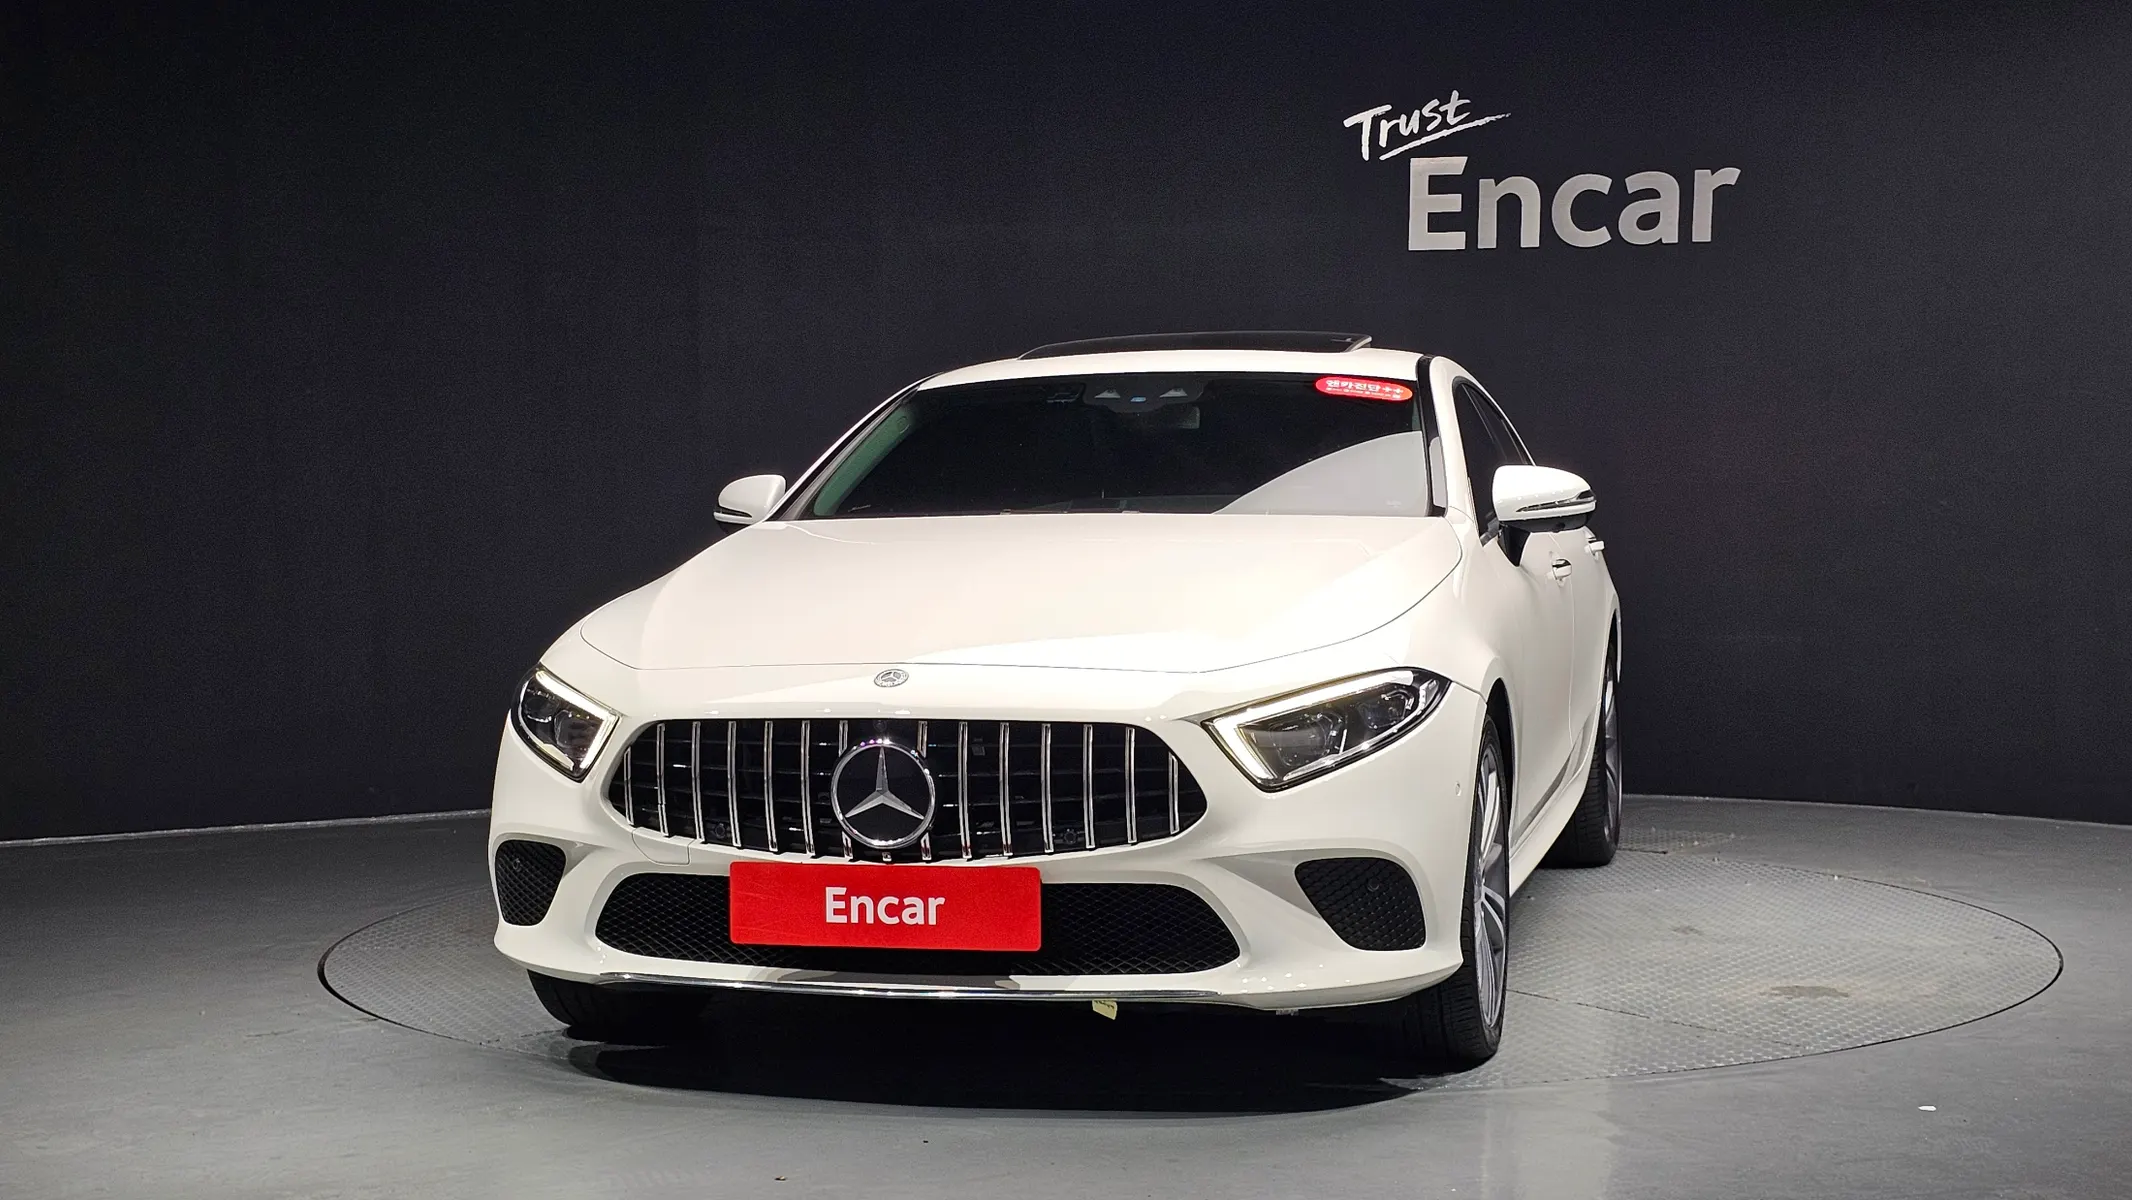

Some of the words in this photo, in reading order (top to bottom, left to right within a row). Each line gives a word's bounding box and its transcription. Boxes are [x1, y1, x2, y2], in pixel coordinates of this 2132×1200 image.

[1343, 89, 1472, 162] Trust
[1408, 156, 1742, 251] Encar
[825, 886, 946, 926] Encar
